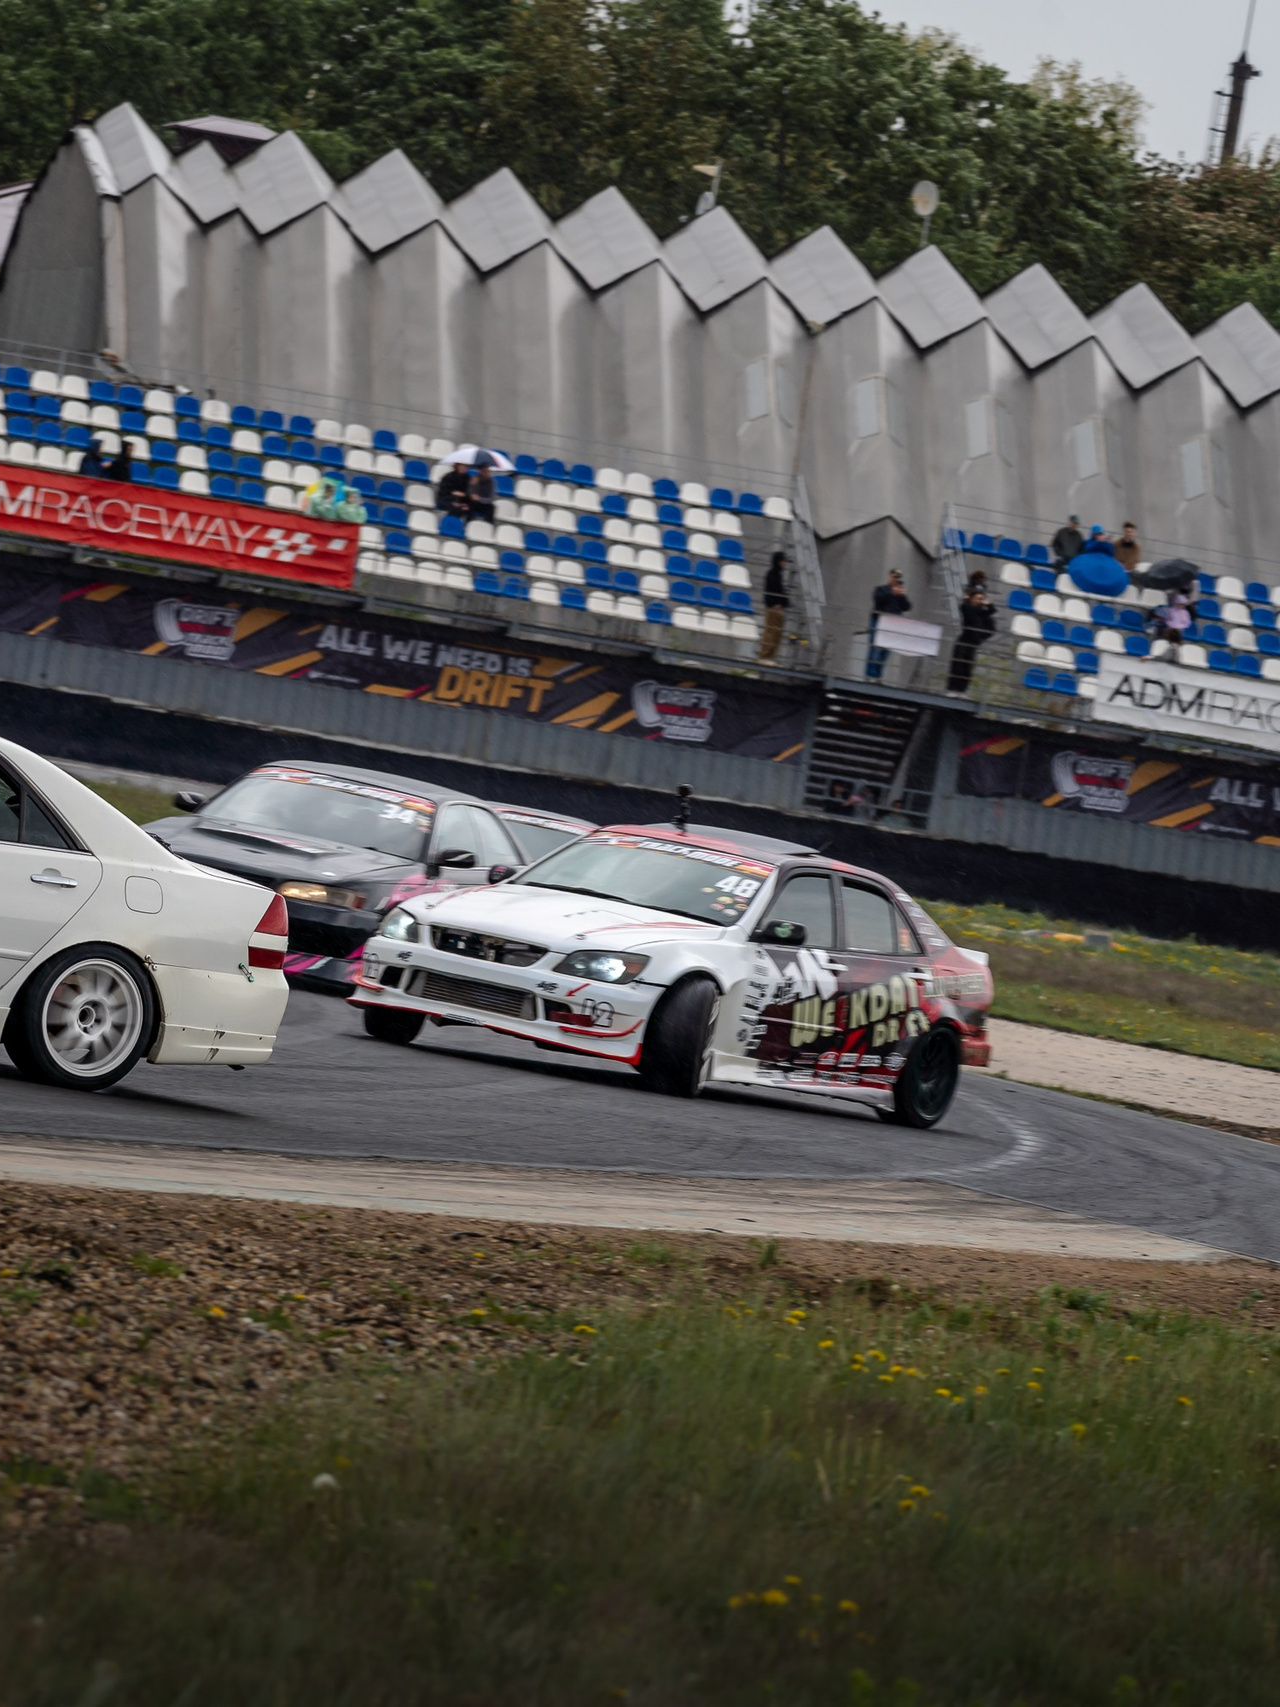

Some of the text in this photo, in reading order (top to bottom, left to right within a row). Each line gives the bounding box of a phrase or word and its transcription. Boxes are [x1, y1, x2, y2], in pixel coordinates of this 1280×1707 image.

[316, 624, 533, 677] ALL WE NEED IS
[434, 665, 554, 713] DRIFT
[1208, 777, 1265, 808] ALL
[378, 804, 418, 824] 34
[714, 875, 761, 898] 48
